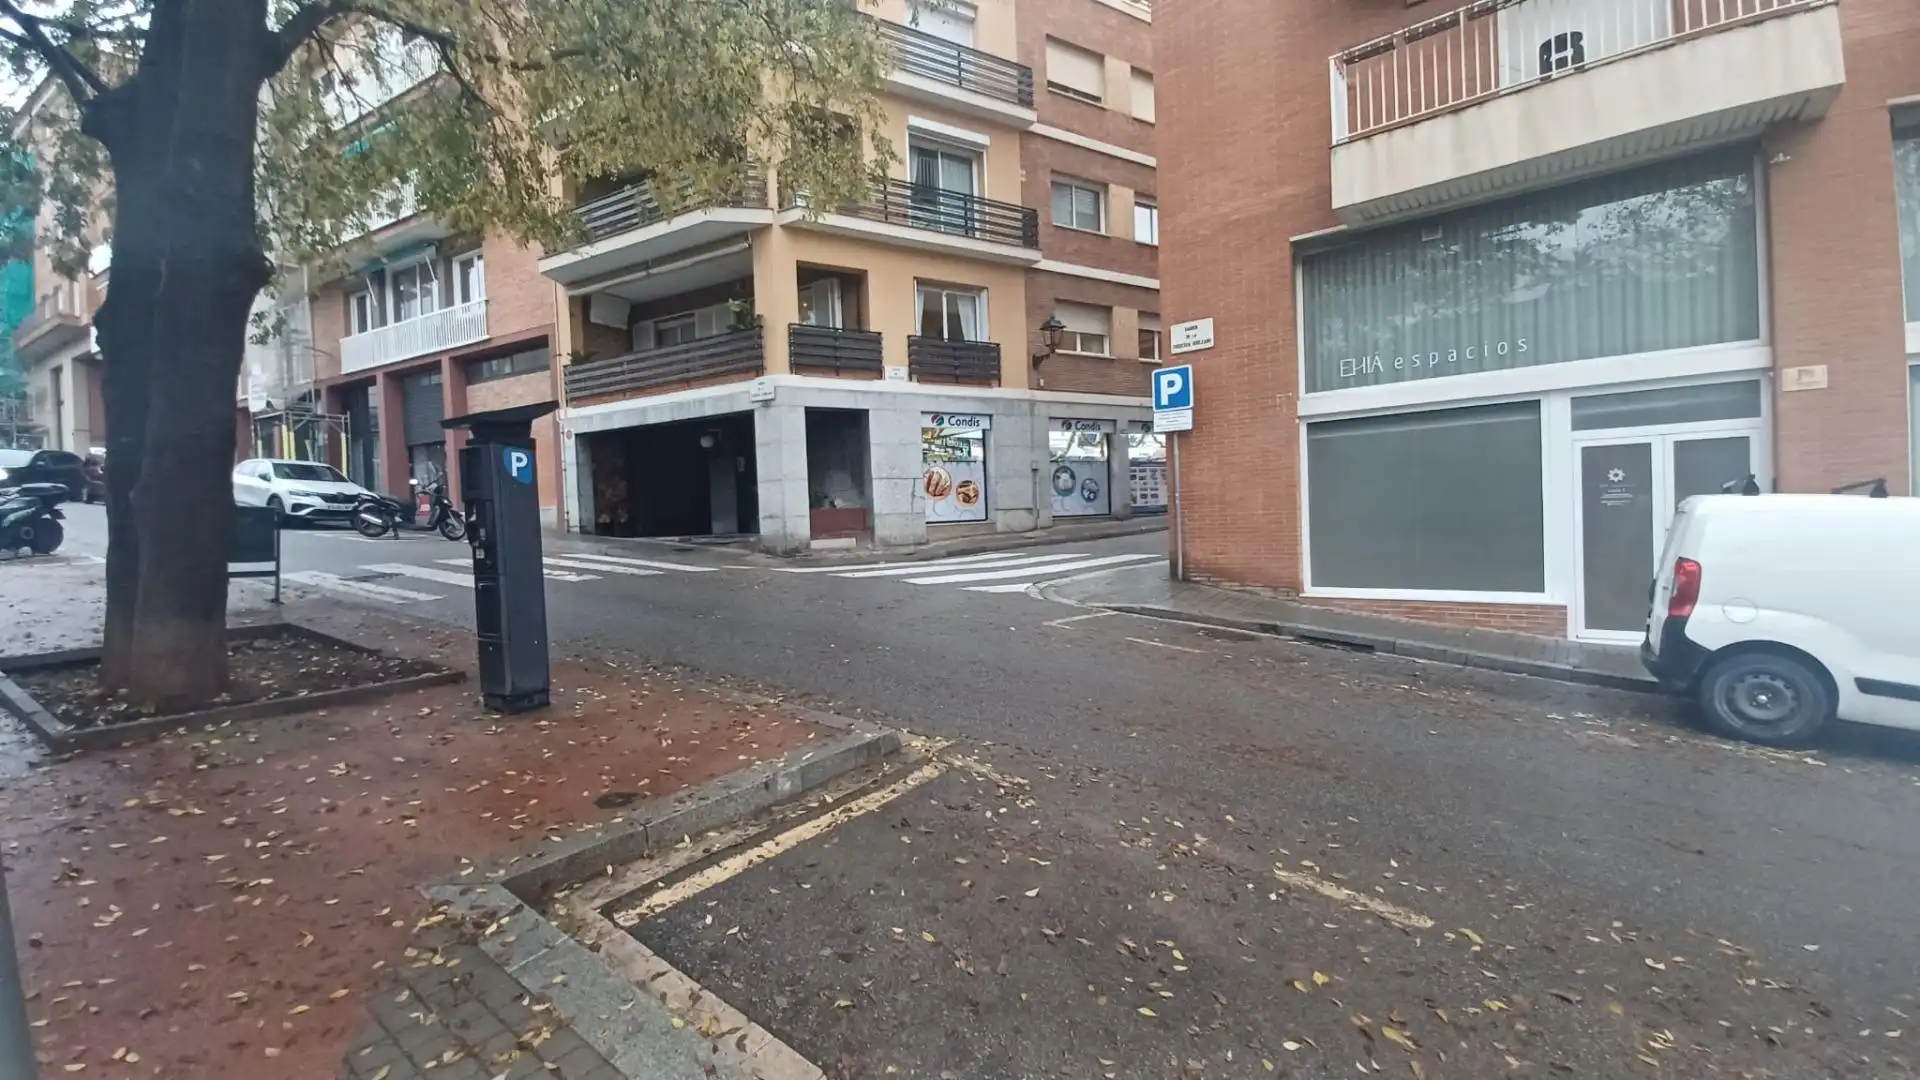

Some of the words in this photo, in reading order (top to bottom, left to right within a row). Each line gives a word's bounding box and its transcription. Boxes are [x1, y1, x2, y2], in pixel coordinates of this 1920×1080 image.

[1394, 338, 1528, 369] espacios
[1160, 373, 1183, 406] P
[948, 415, 981, 427] Condis
[1075, 420, 1101, 432] Condis
[511, 452, 528, 477] P
